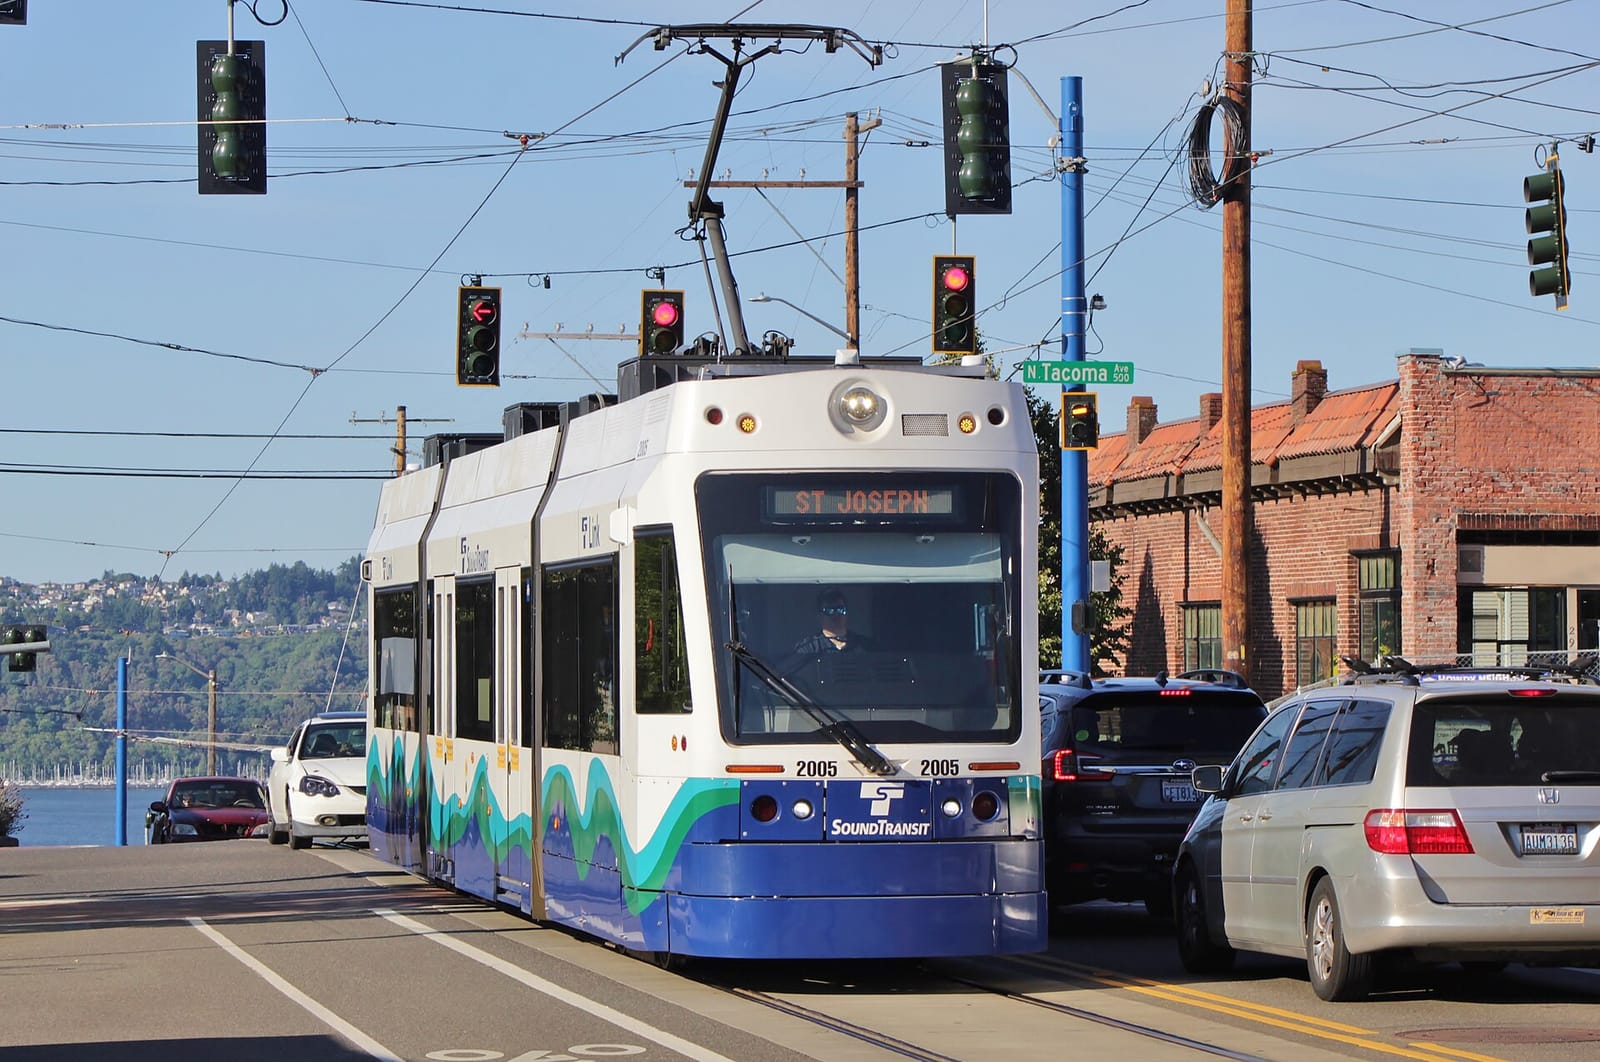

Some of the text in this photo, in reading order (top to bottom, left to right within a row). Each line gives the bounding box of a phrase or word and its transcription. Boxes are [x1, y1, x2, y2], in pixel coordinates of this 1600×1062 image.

[1042, 362, 1108, 382] Tacoma
[1113, 364, 1129, 373] Ave
[795, 489, 929, 514] ST JOSEPH
[796, 760, 838, 777] 2005
[920, 759, 959, 776] 2005
[1525, 834, 1574, 849] AUM3136
